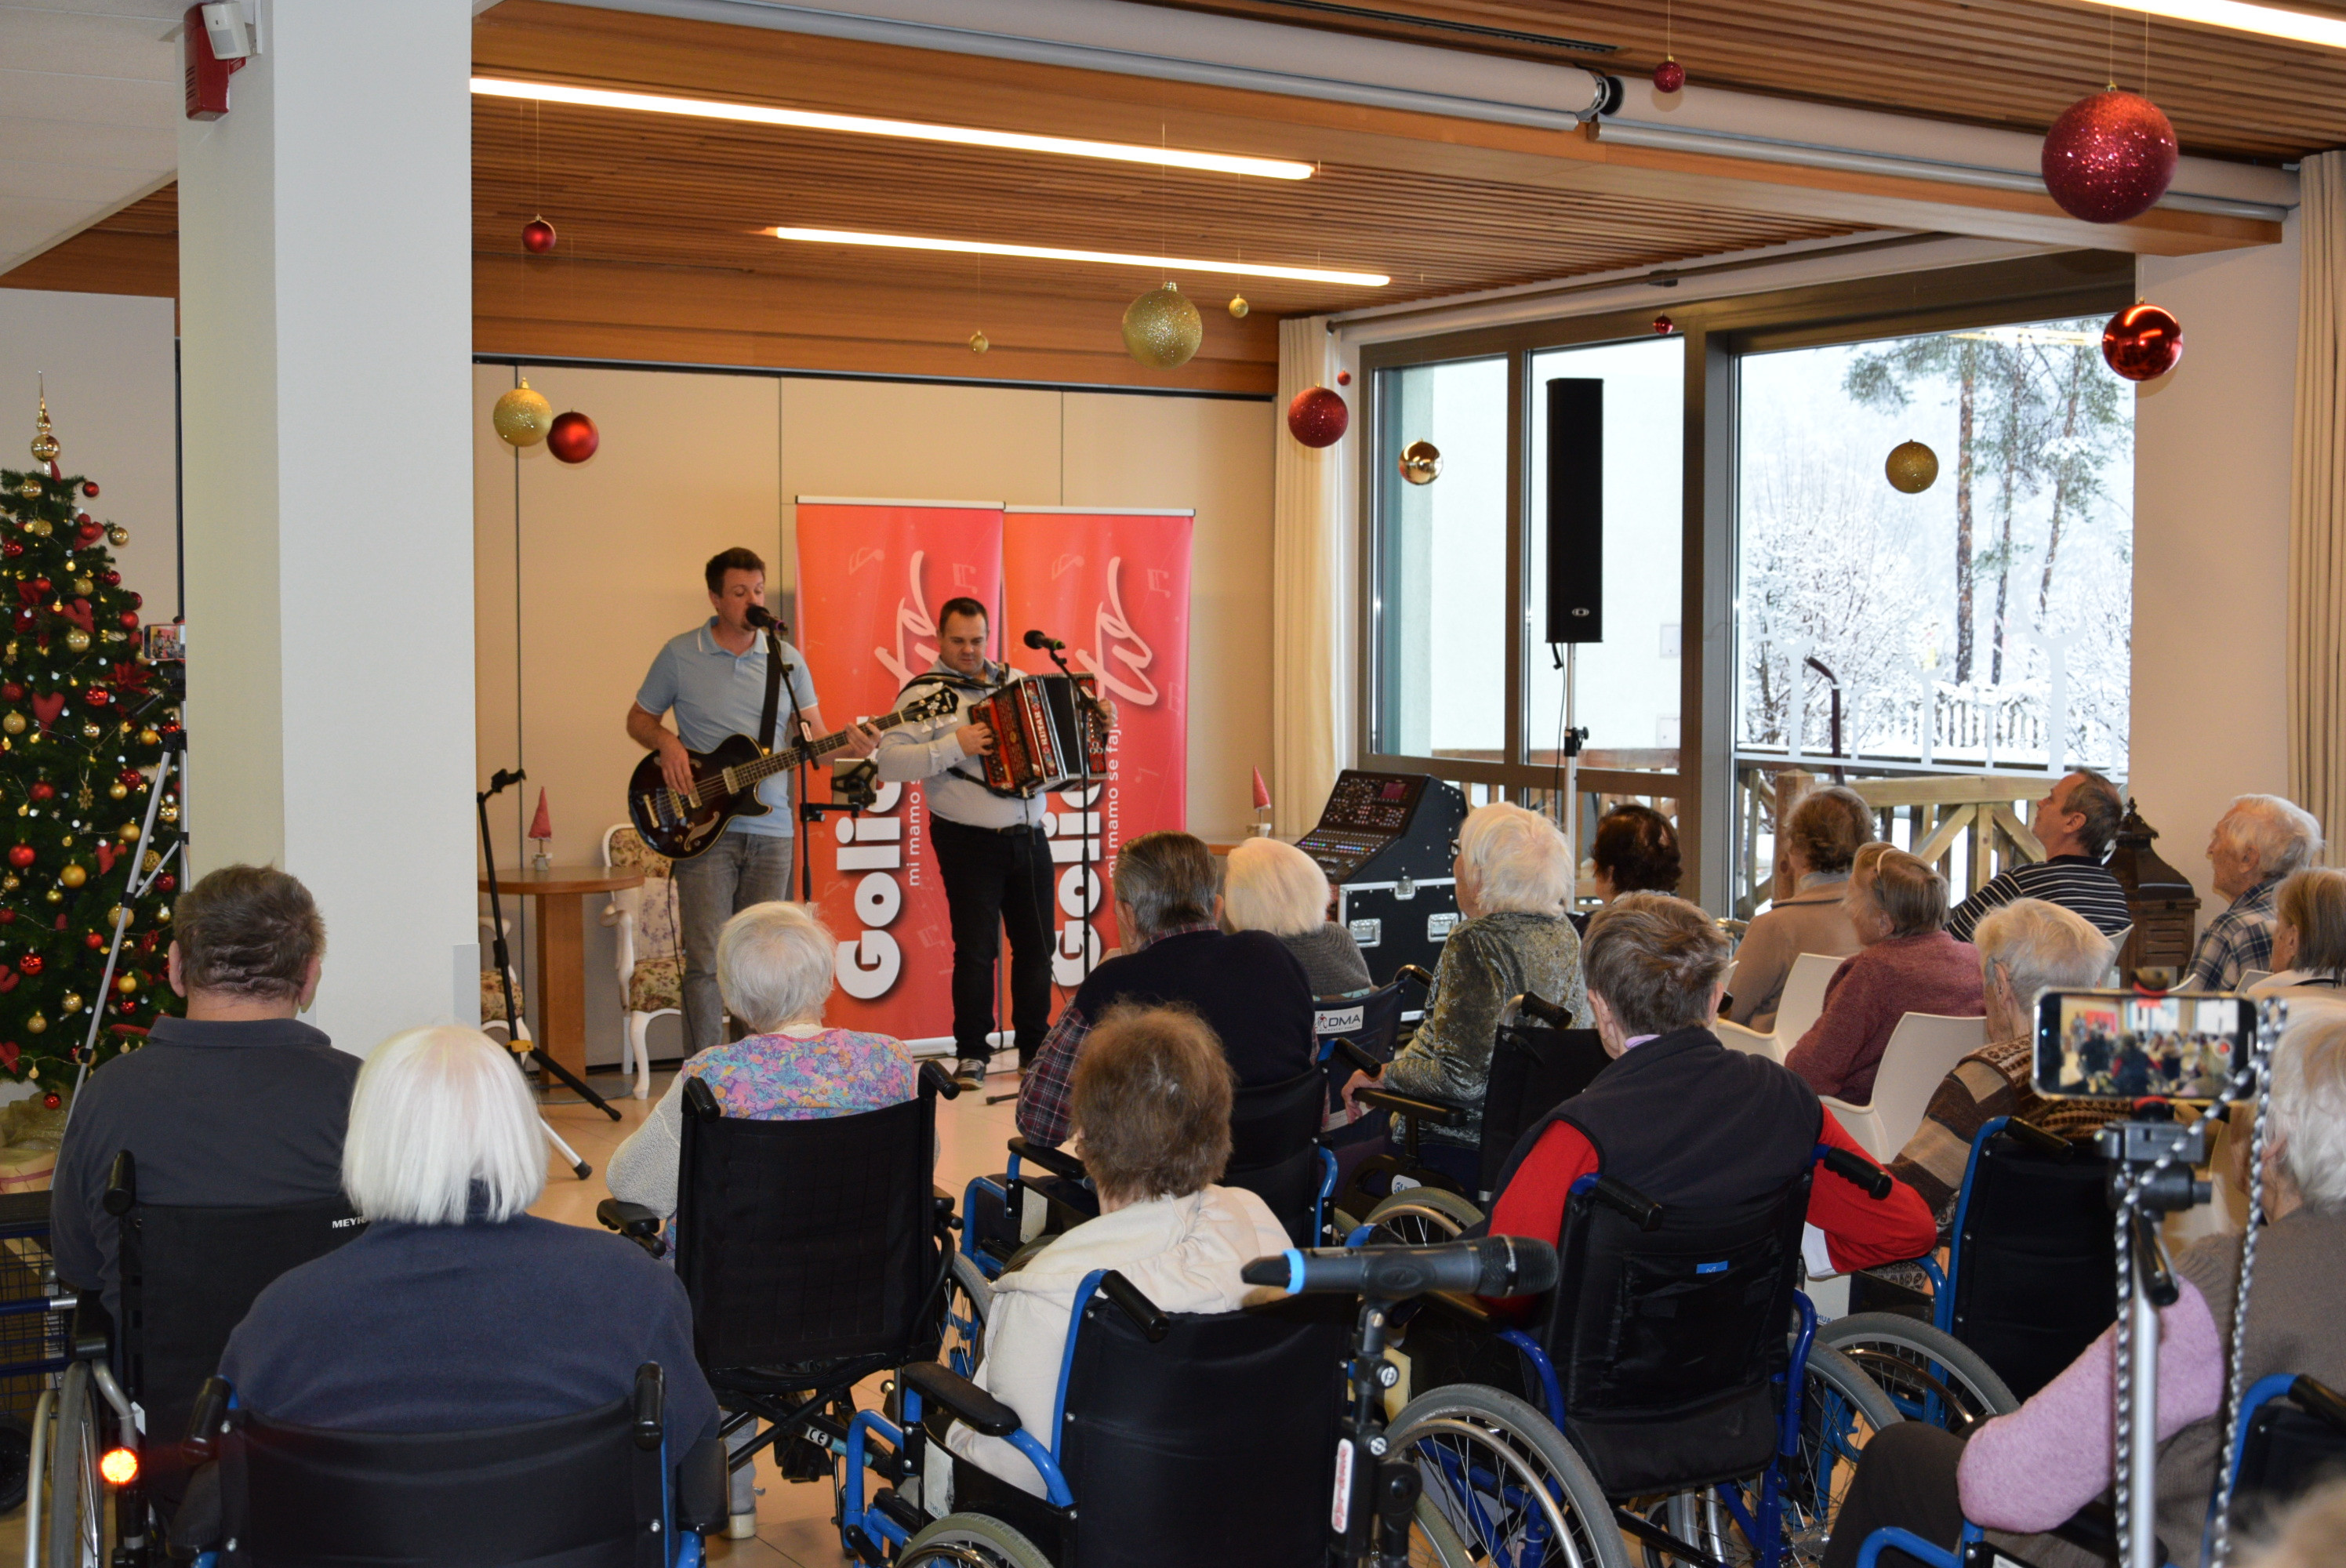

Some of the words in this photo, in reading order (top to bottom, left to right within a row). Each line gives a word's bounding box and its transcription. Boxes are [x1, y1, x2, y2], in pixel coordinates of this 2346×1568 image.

[1034, 711, 1049, 746] RUTAR
[1106, 717, 1121, 753] faj
[1108, 759, 1119, 781] se
[910, 791, 921, 855] mamo
[1108, 787, 1119, 849] mamo
[835, 716, 902, 1000] Goli
[906, 862, 921, 887] mi
